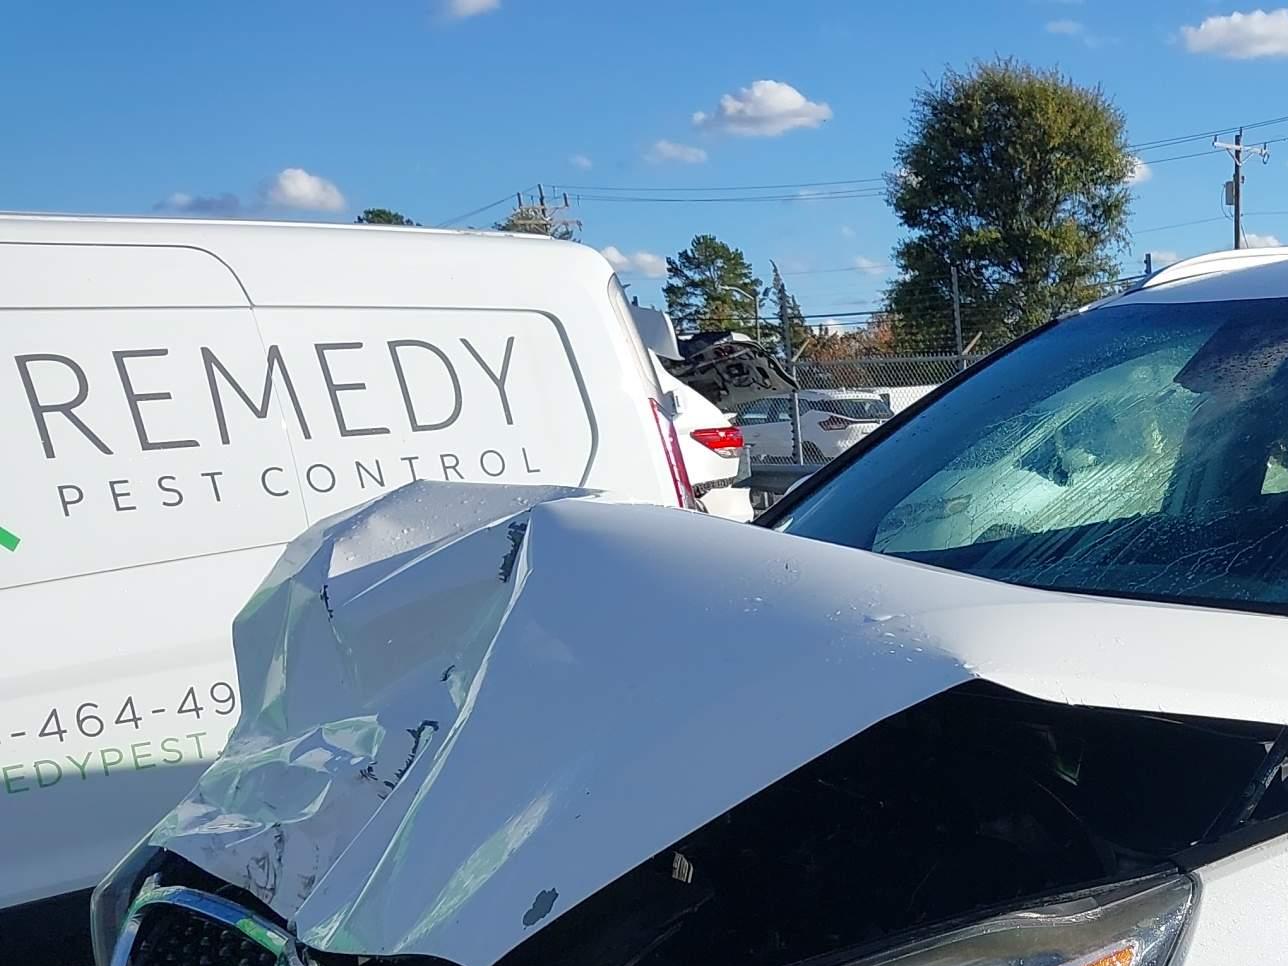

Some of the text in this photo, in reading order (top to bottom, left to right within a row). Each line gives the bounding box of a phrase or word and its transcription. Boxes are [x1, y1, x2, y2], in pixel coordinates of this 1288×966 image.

[14, 335, 516, 459] REMEDY
[57, 447, 541, 517] PEST CONTROL
[0, 681, 236, 744] -464-49
[2, 728, 234, 794] EDYPEST.
